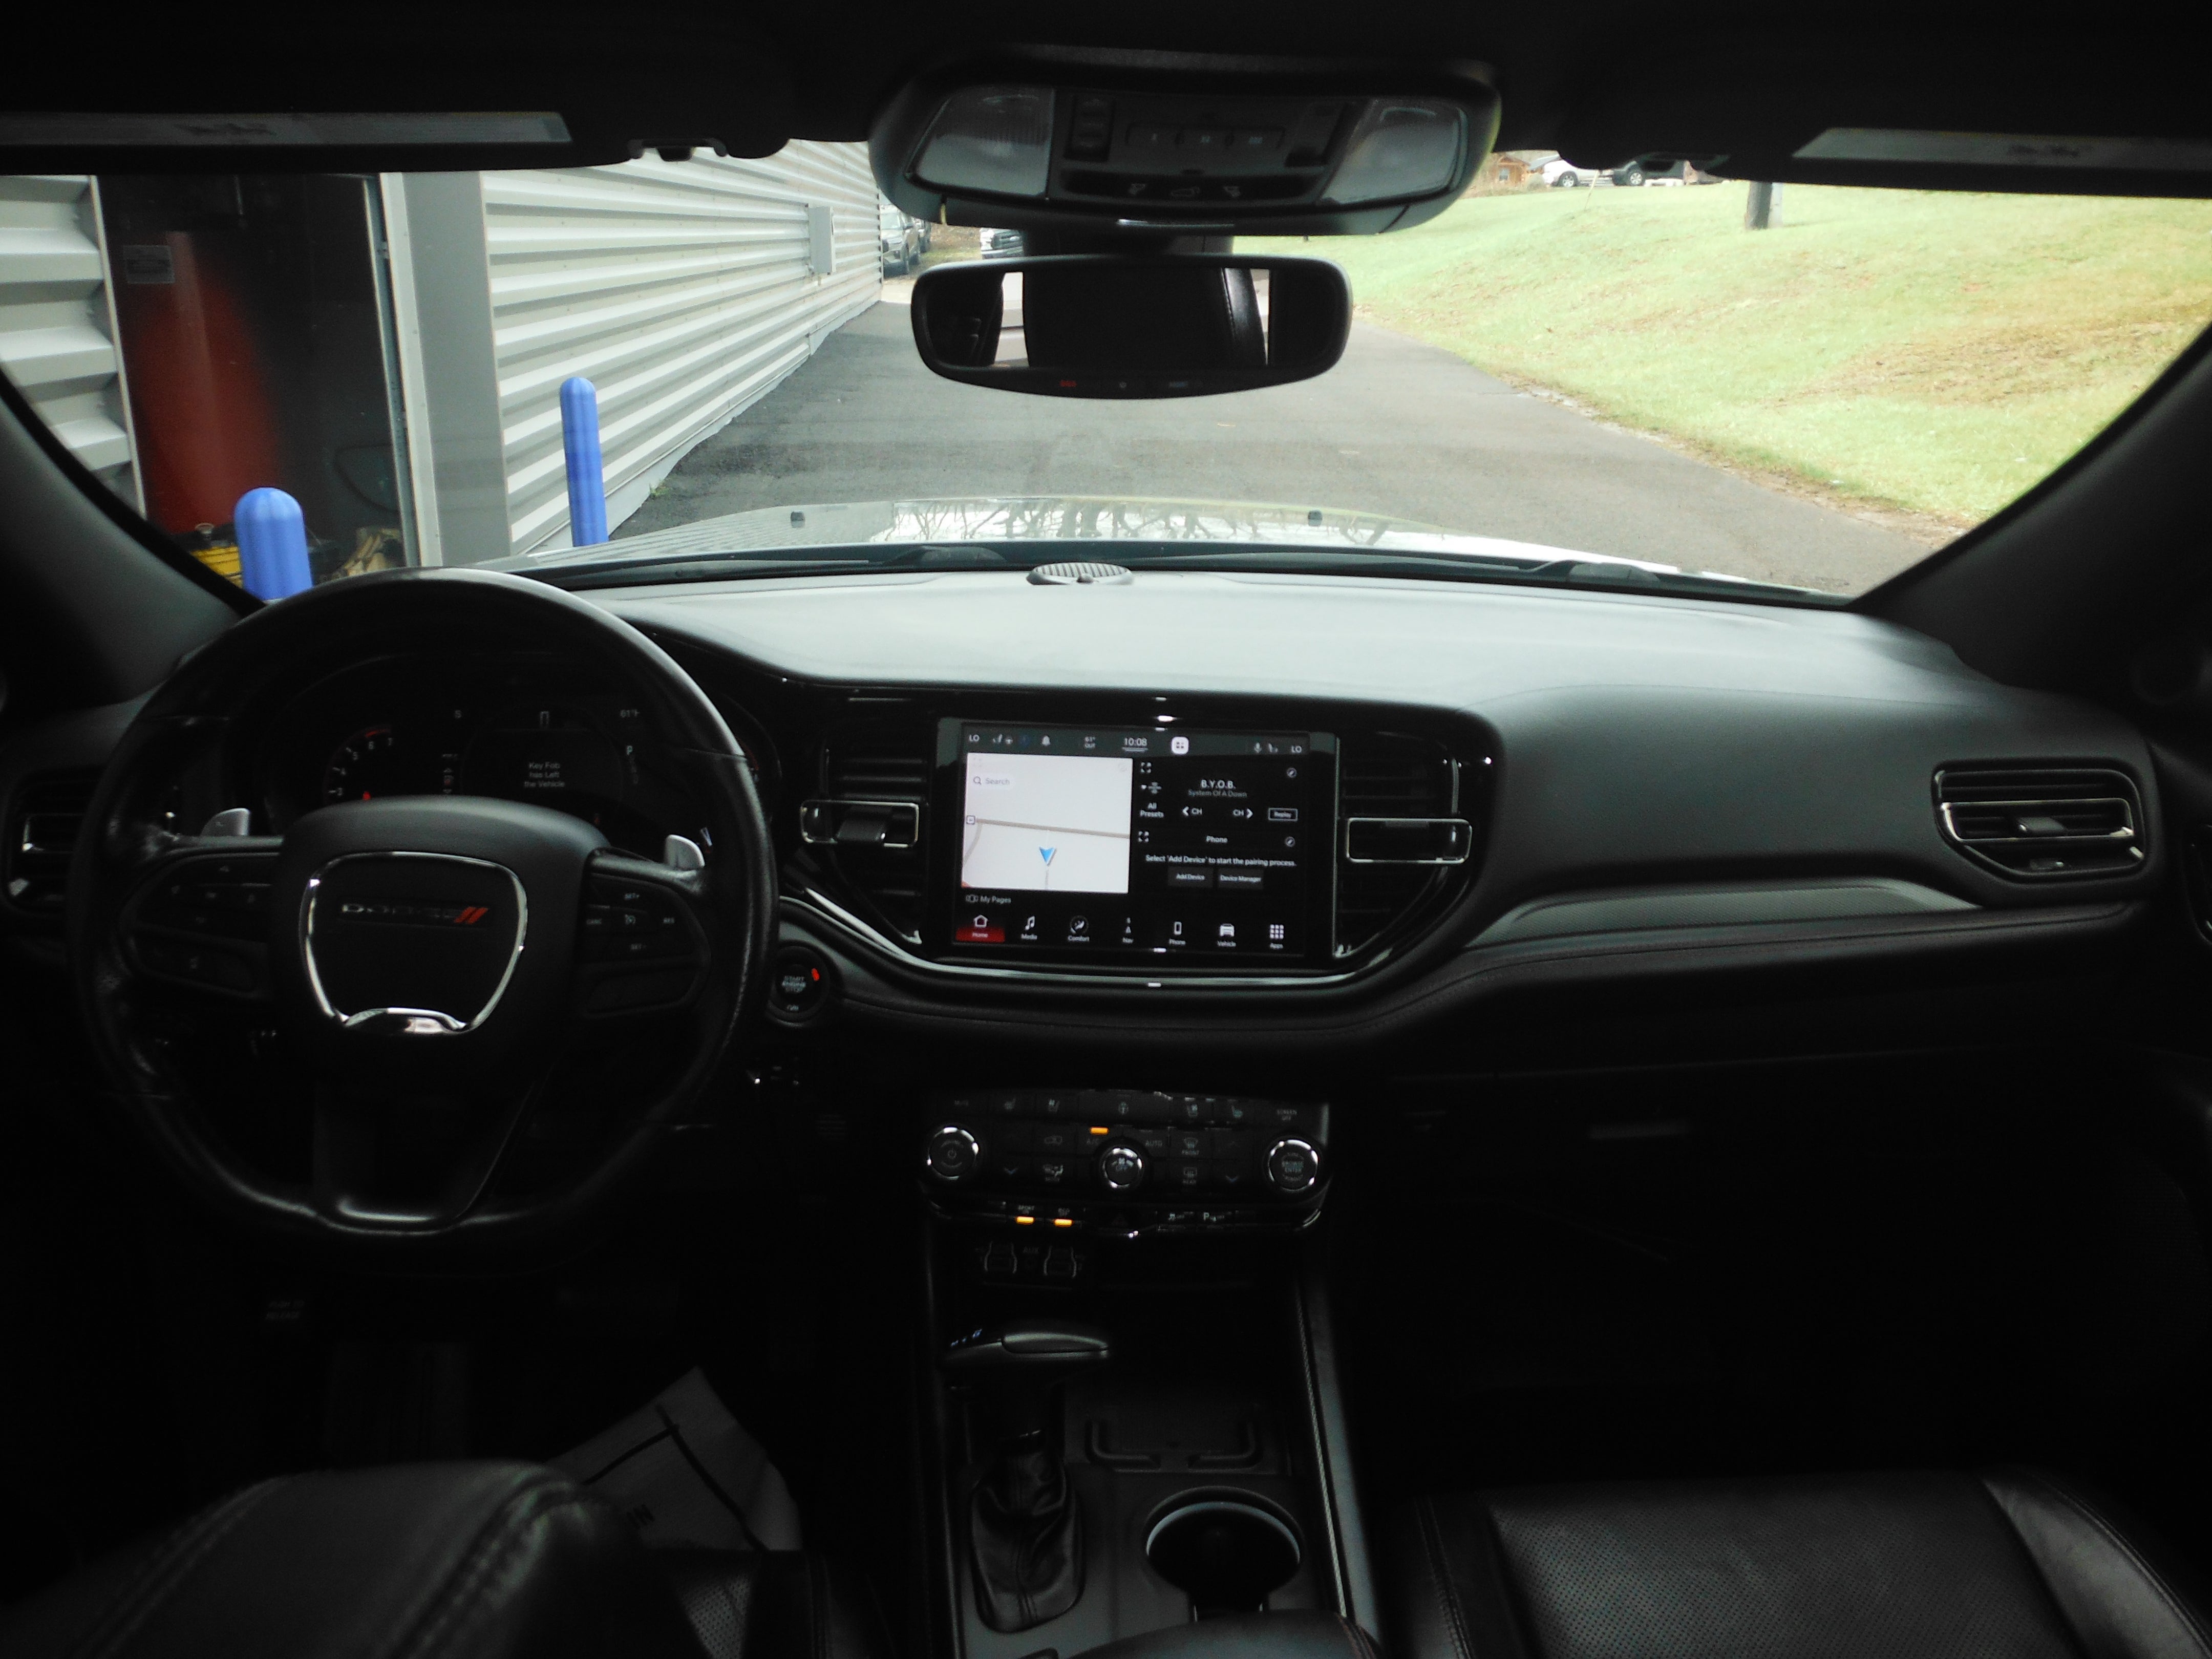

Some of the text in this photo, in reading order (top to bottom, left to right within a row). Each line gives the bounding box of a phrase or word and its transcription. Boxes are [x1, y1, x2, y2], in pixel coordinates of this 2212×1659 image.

[1124, 737, 1147, 747] 10:08
[626, 746, 633, 756] P
[529, 762, 543, 770] Key
[985, 777, 1010, 785] Search
[1201, 779, 1236, 789] B.Y.O.B.
[1140, 810, 1164, 818] Presets
[1206, 835, 1227, 843] Phone
[1245, 858, 1268, 866] pairing
[980, 896, 1012, 904] My Pages
